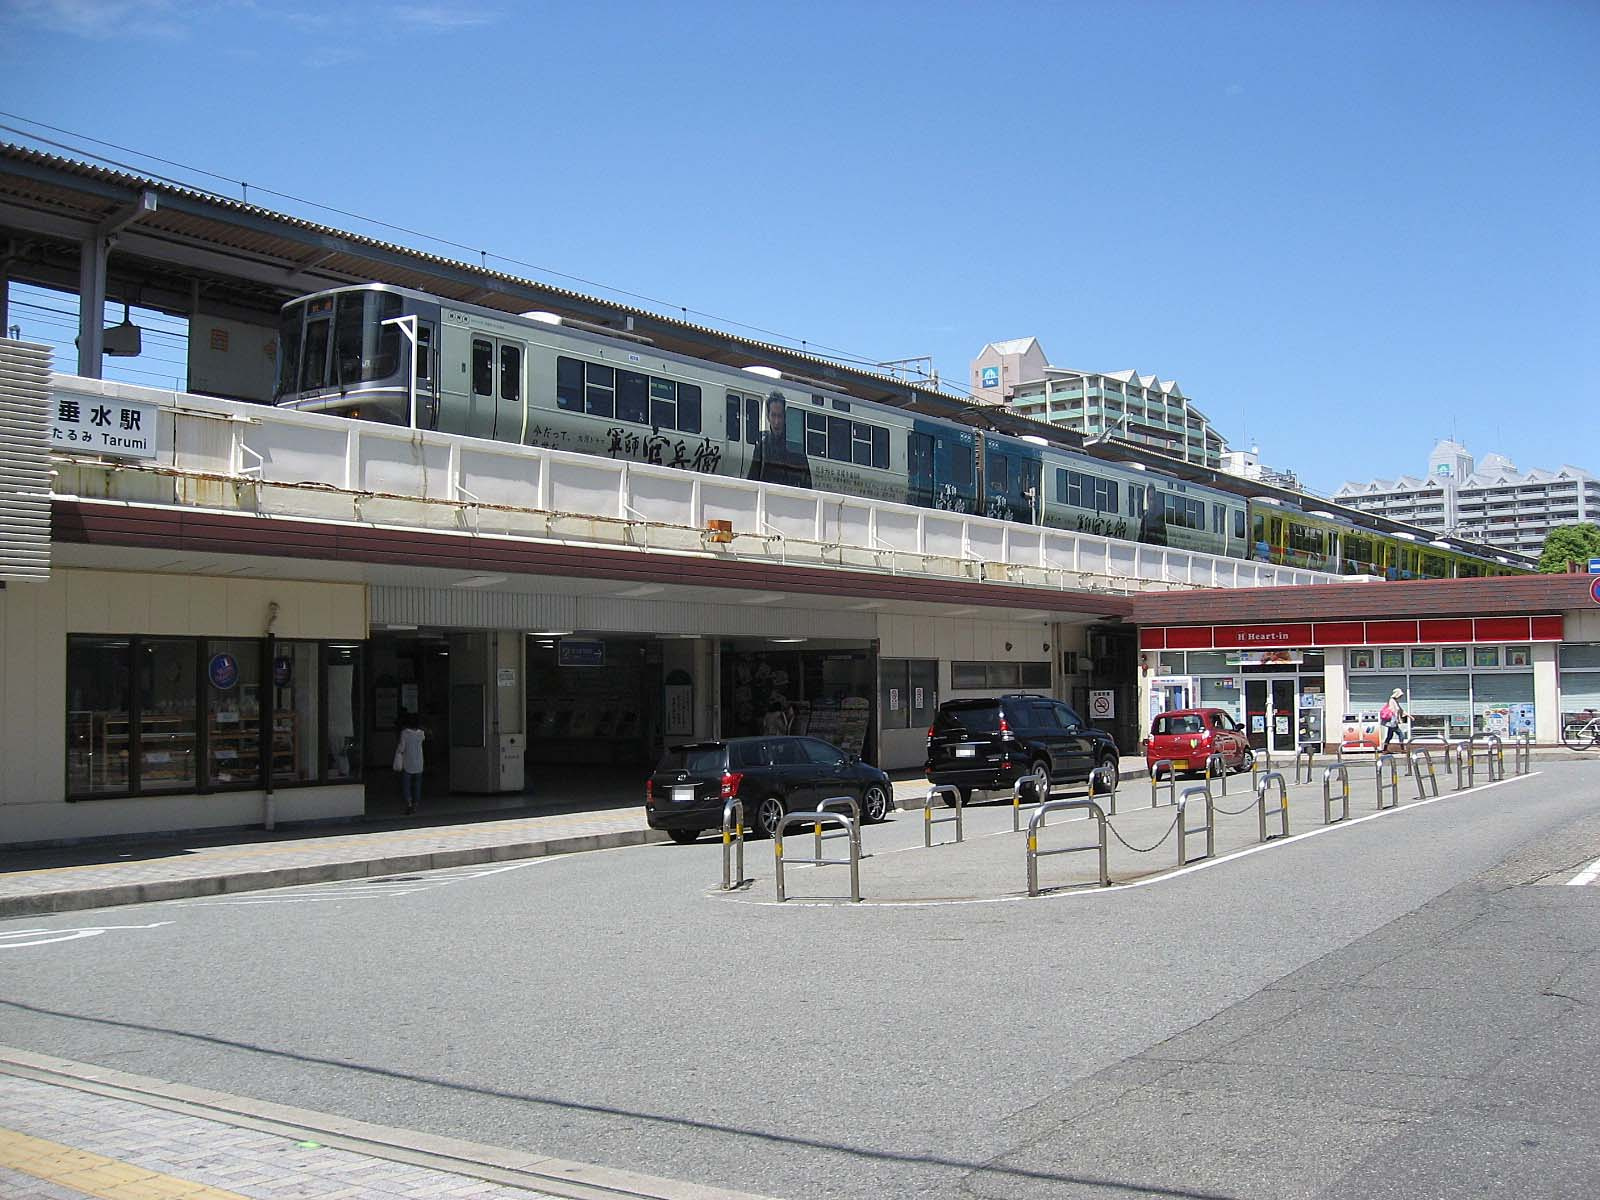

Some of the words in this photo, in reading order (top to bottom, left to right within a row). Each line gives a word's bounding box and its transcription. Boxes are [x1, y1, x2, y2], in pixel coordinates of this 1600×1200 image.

[58, 400, 141, 431] 垂水駅
[52, 427, 92, 442] たるみ
[102, 433, 147, 450] Tarumi
